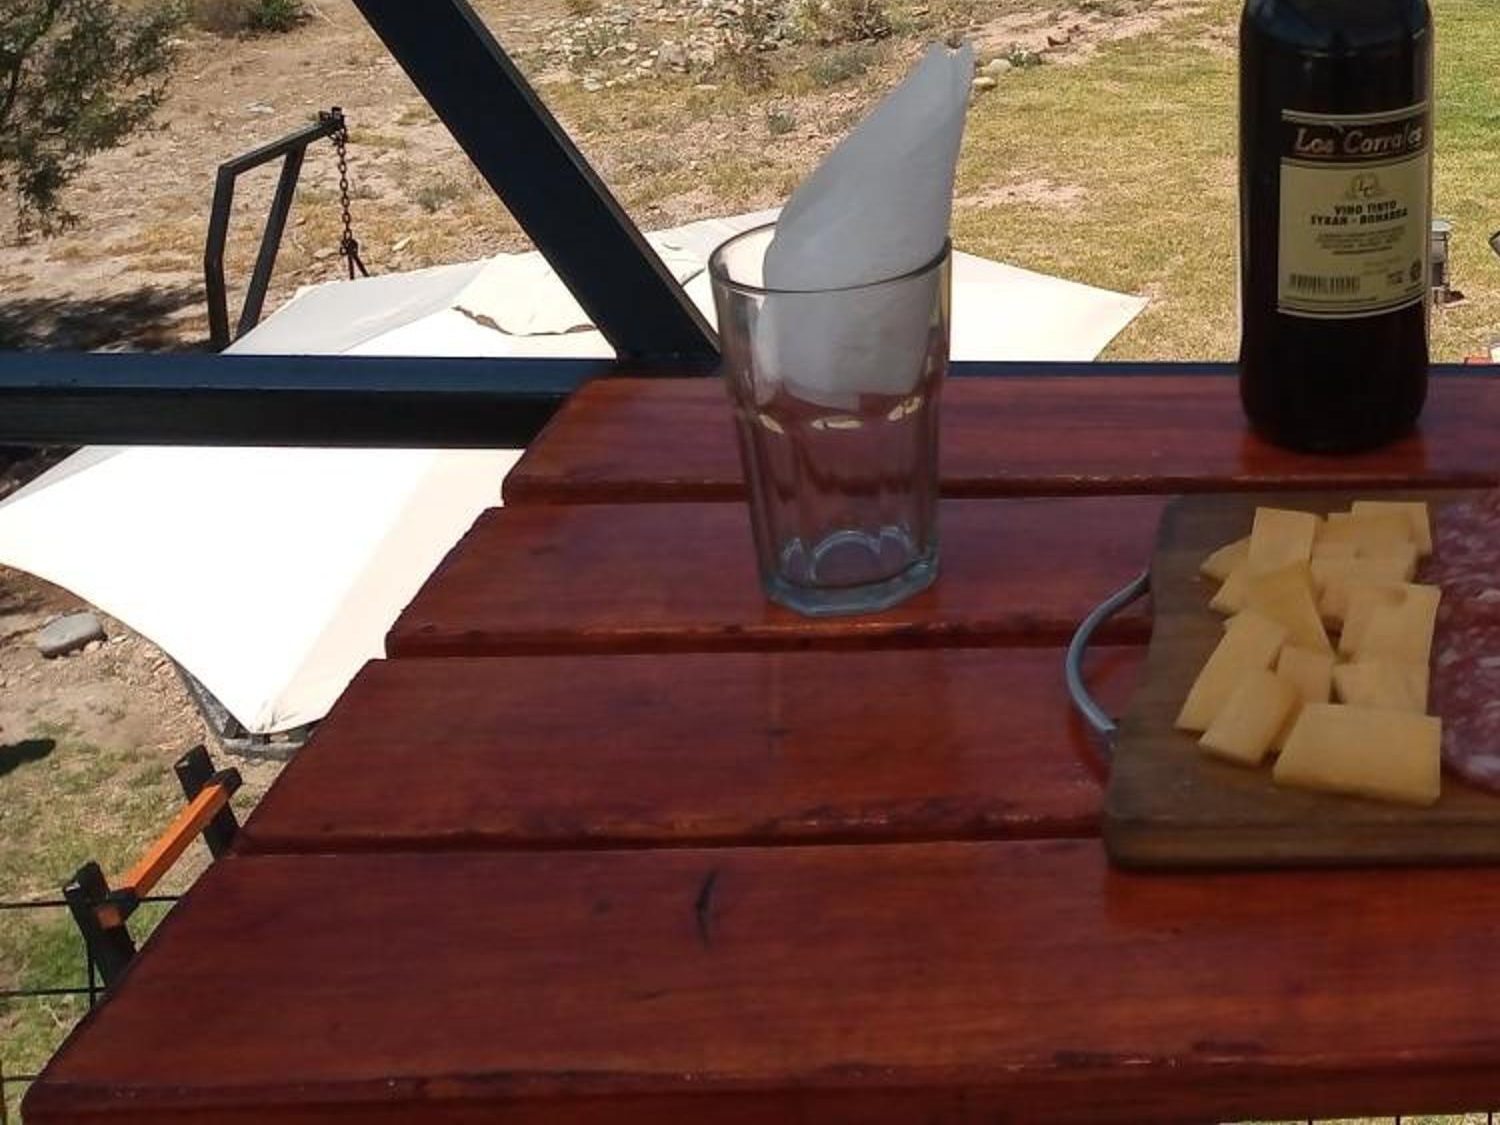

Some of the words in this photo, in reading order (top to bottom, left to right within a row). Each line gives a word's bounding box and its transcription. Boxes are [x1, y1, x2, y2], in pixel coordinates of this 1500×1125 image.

[1296, 127, 1335, 154] Los
[1335, 203, 1363, 216] VINO
[1367, 200, 1397, 214] TINTO
